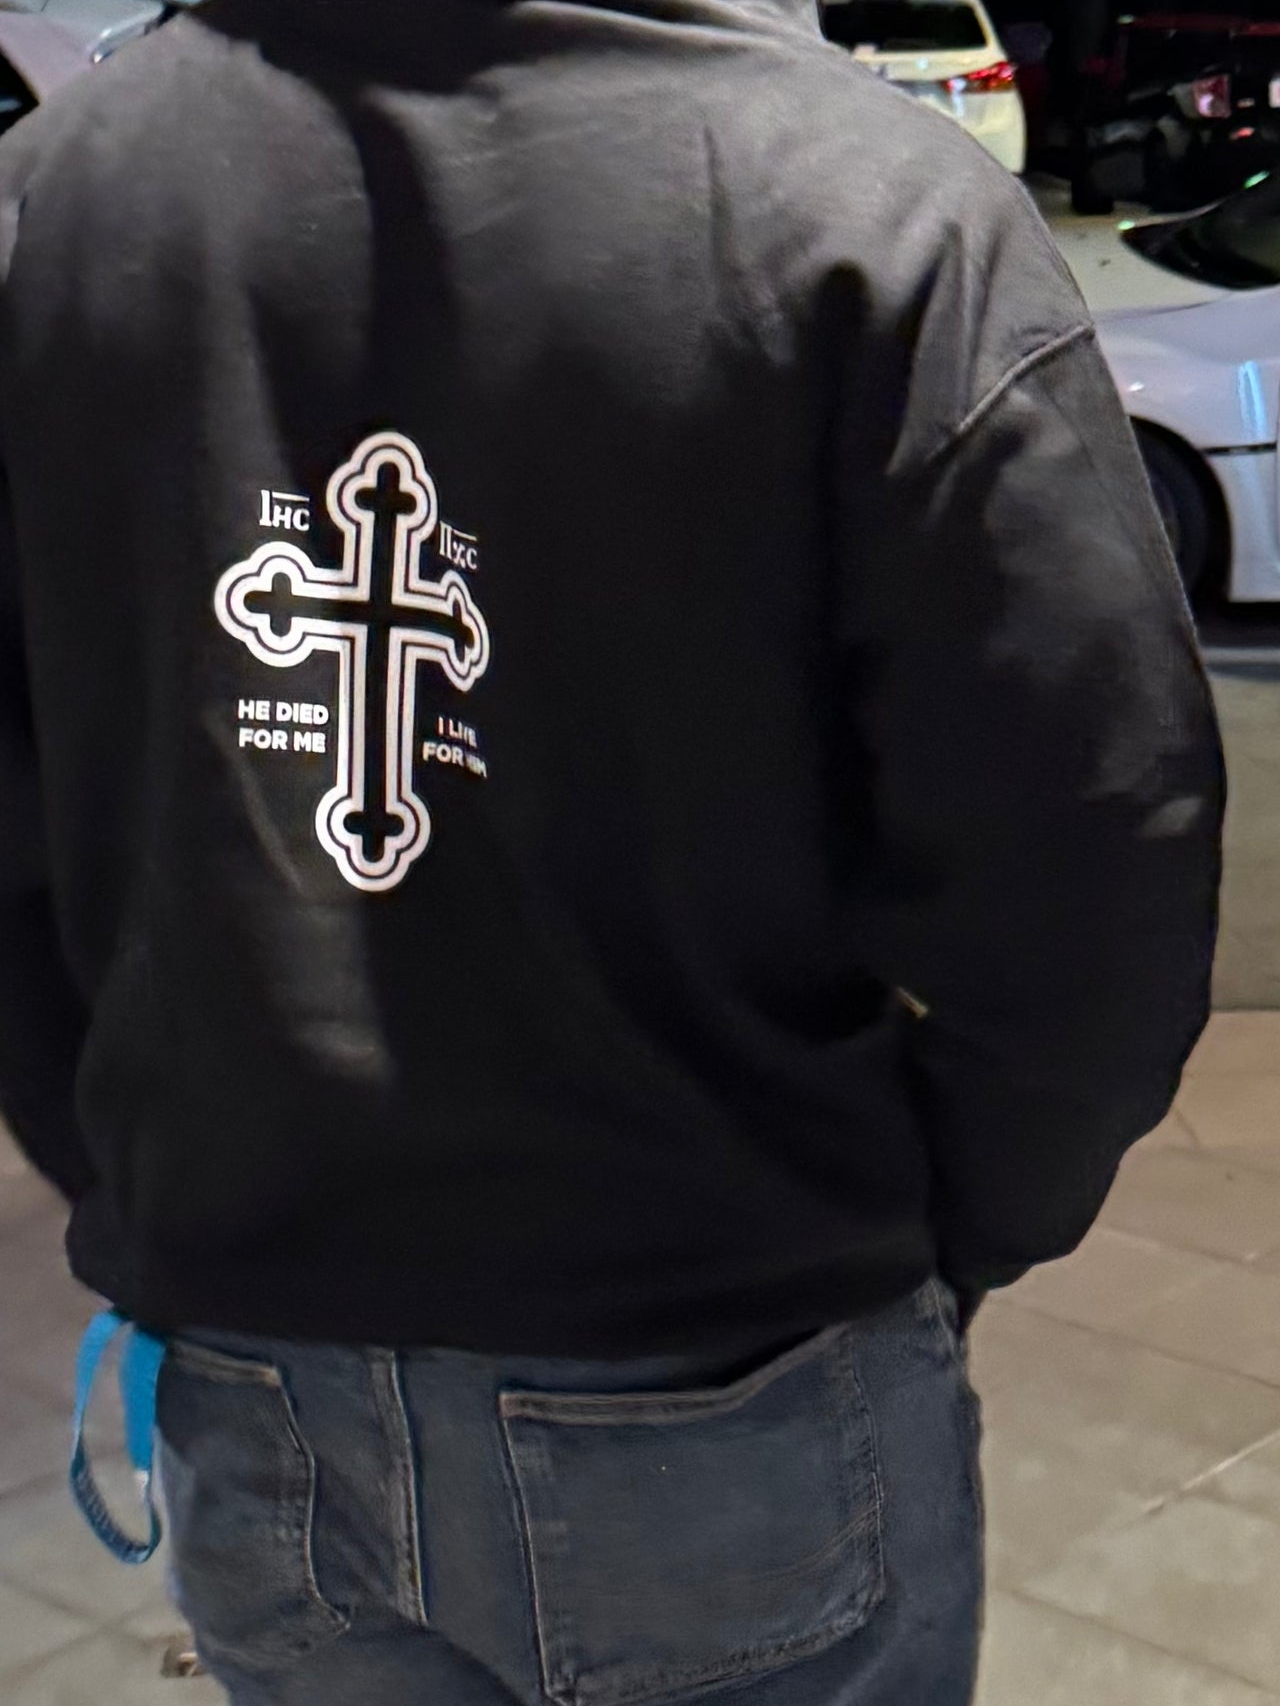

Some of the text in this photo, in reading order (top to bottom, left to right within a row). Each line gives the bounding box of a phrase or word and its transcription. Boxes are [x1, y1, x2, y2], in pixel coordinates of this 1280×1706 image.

[238, 699, 329, 725] HE DIED
[438, 716, 444, 735] I
[238, 728, 326, 754] FOR ME
[422, 741, 464, 767] FOR
